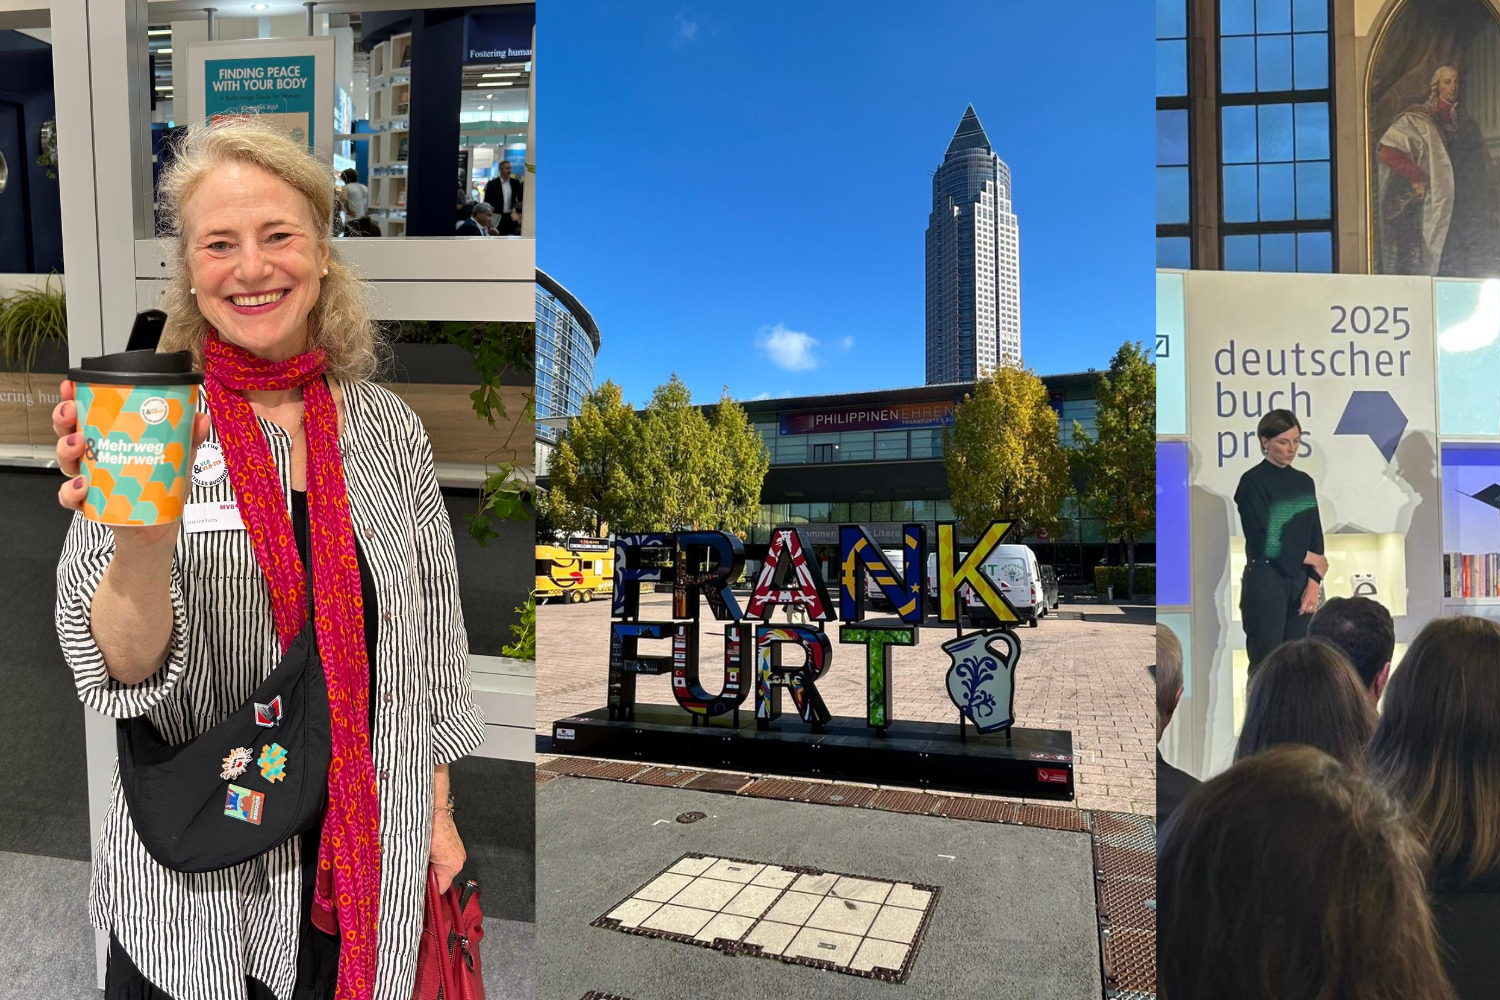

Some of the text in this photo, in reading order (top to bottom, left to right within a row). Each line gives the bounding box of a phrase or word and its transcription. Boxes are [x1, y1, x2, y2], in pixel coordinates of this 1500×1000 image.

[469, 49, 506, 59] Fostering
[219, 65, 300, 80] FINDING PEACE
[212, 77, 308, 92] WITH YOUR BODY
[1330, 305, 1411, 341] 2025
[1214, 339, 1411, 377] deutscher
[1216, 381, 1312, 418] buch
[816, 409, 899, 426] PHILIPPINEN
[86, 437, 99, 461] &
[98, 438, 165, 455] Mehrweg
[1217, 430, 1313, 468] prs
[98, 450, 166, 466] Mehrwert
[200, 459, 211, 467] VLB
[612, 519, 1023, 624] FRANK
[608, 620, 920, 725] FURT
